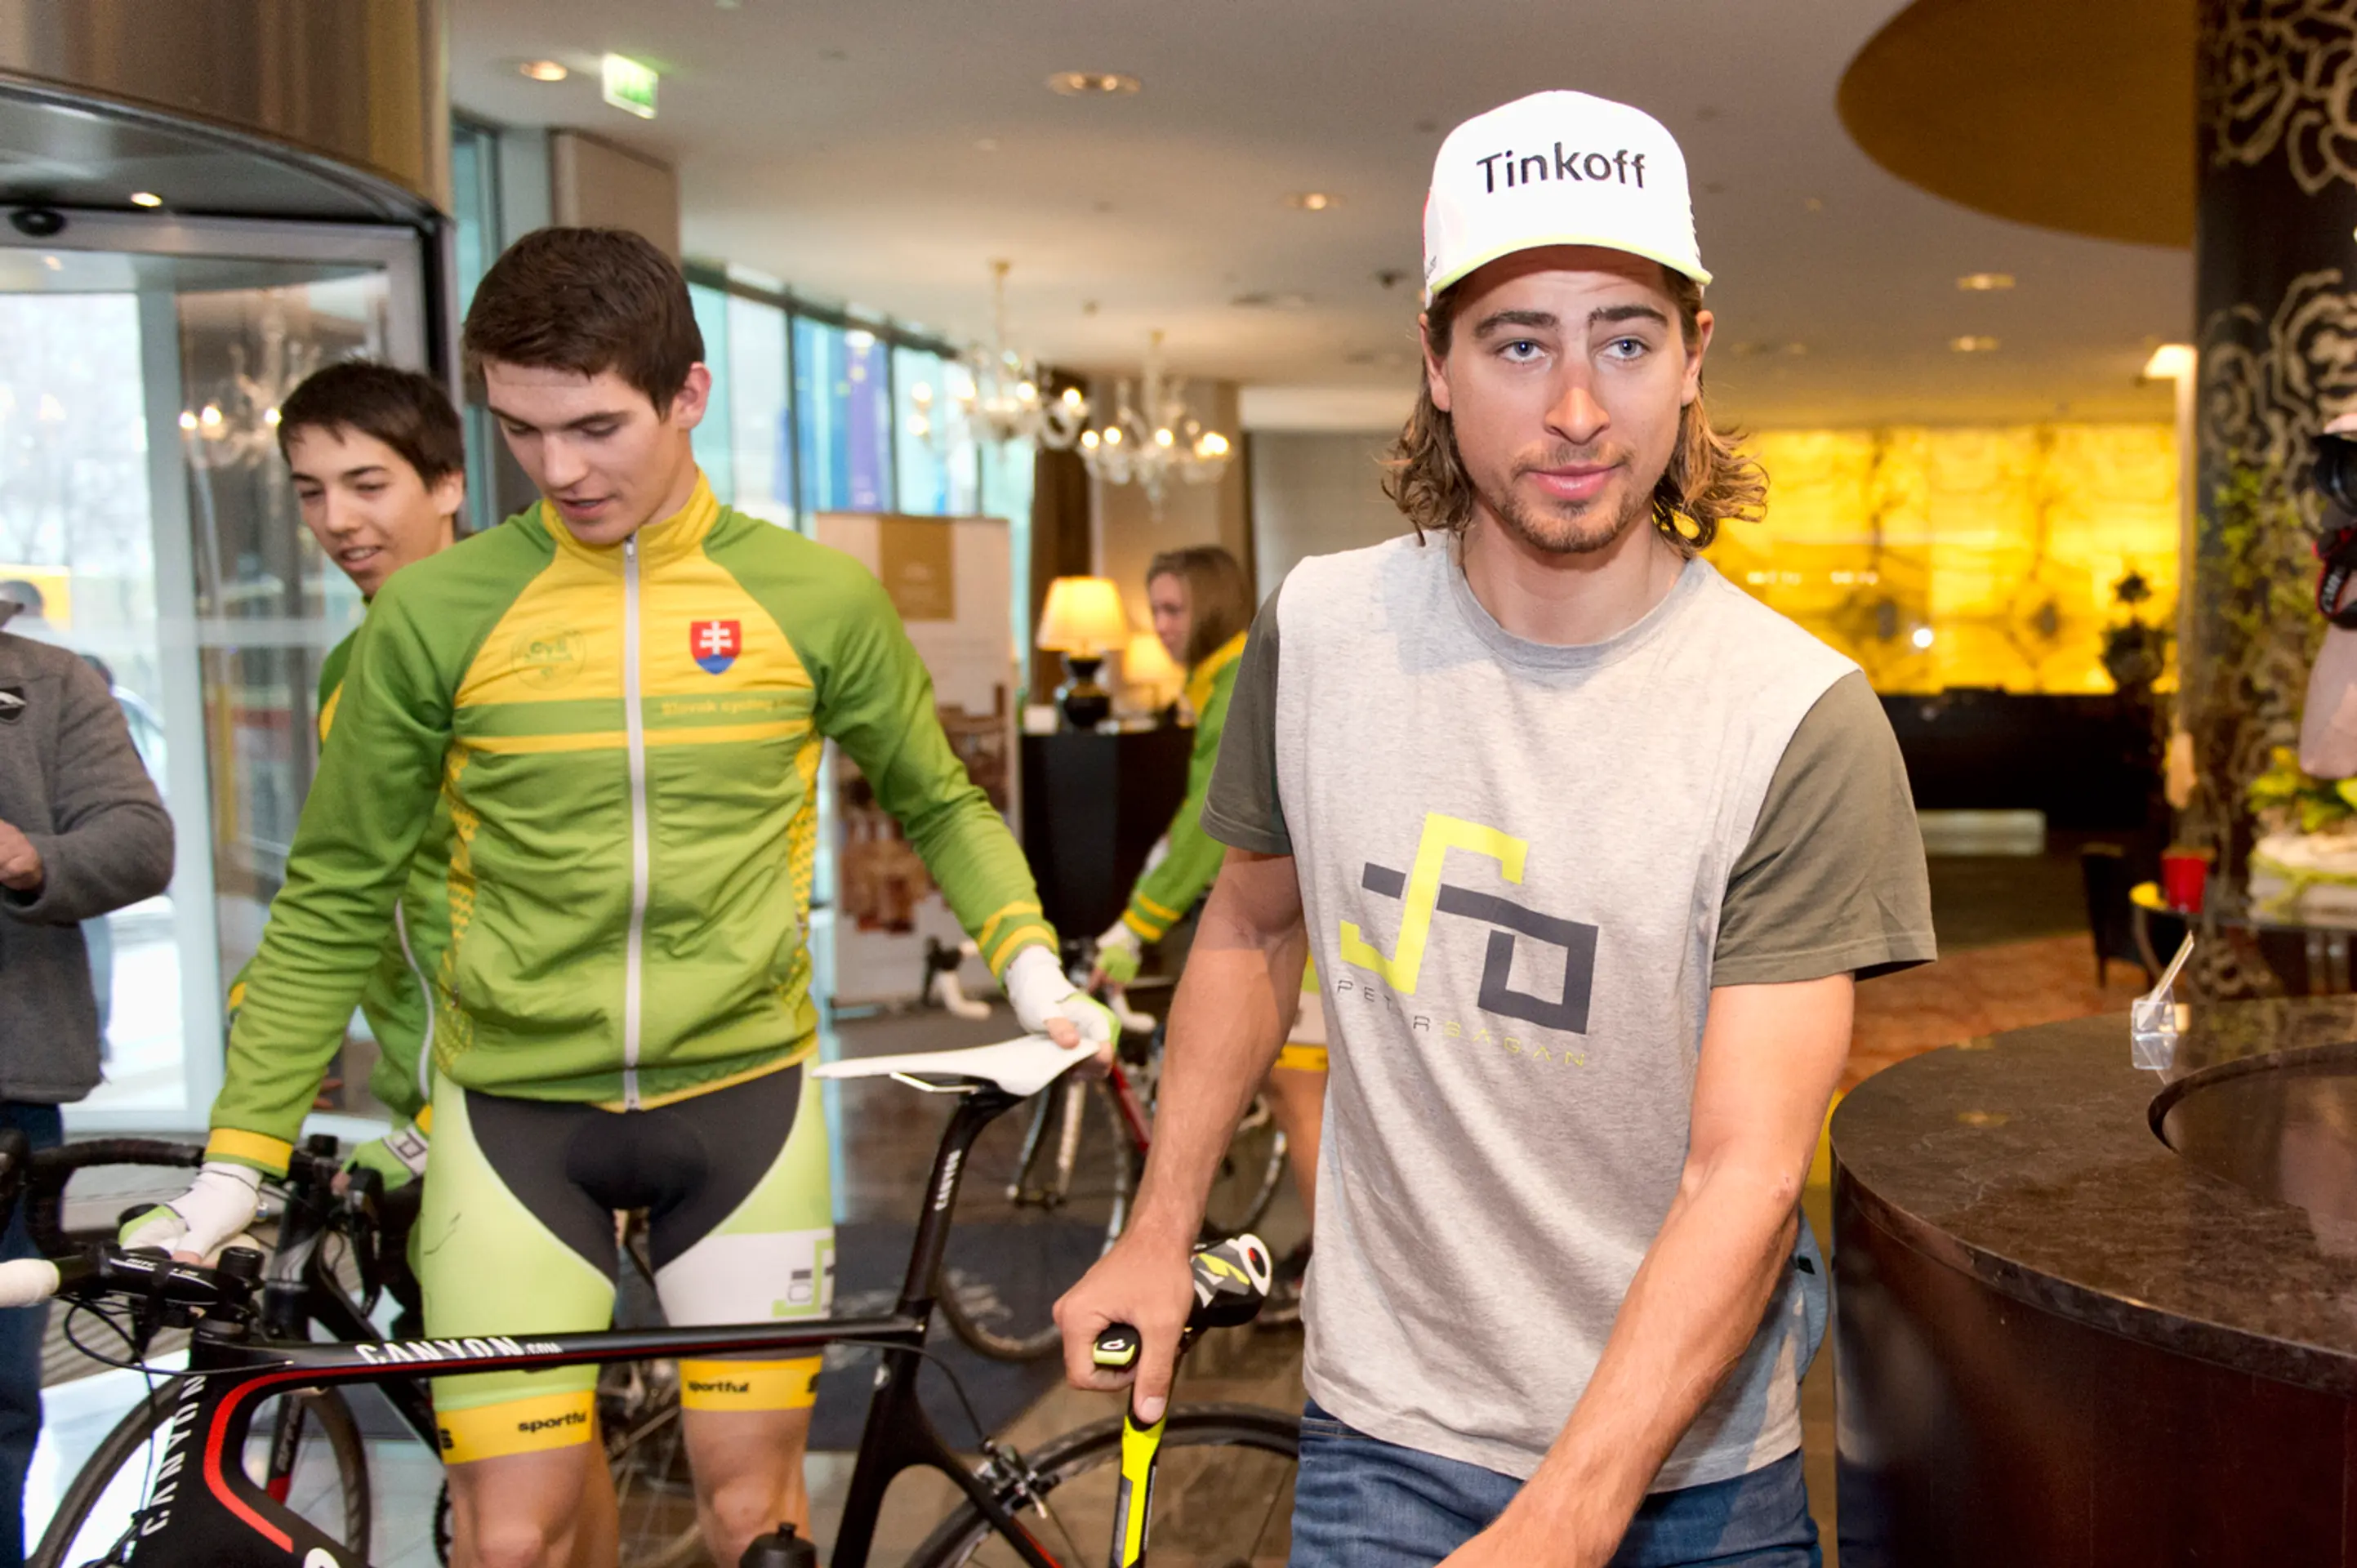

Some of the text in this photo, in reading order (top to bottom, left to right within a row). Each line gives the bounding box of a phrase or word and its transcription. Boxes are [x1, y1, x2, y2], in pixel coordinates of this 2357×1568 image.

[1477, 141, 1646, 194] Tinkoff
[1337, 979, 1585, 1067] PETR SAGAN
[140, 1375, 207, 1537] CANYON
